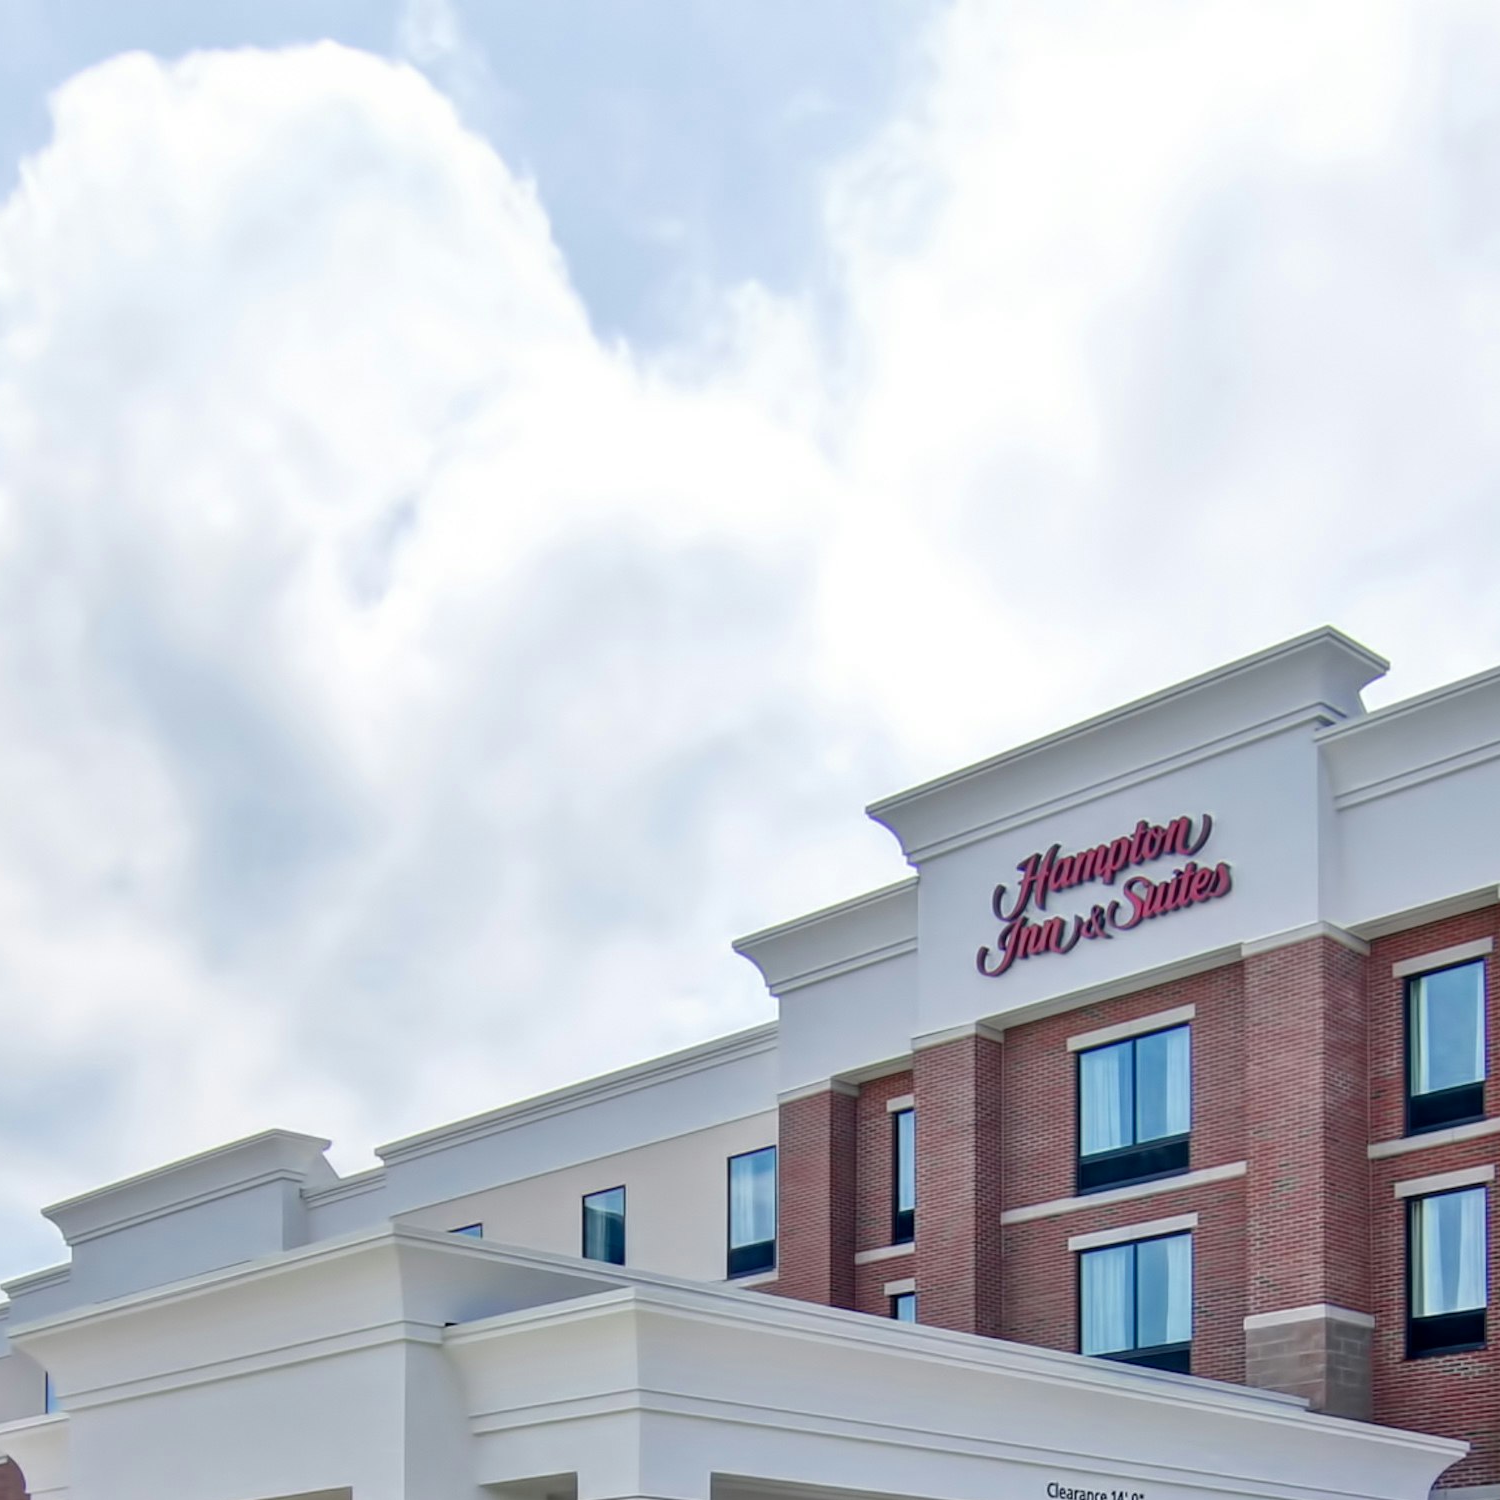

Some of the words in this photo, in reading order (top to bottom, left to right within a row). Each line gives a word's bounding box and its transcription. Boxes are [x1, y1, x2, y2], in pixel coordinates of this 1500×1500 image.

[976, 914, 1083, 977] Inn
[1082, 904, 1113, 939] &
[1106, 862, 1232, 930] Suites
[992, 814, 1212, 922] Hampton
